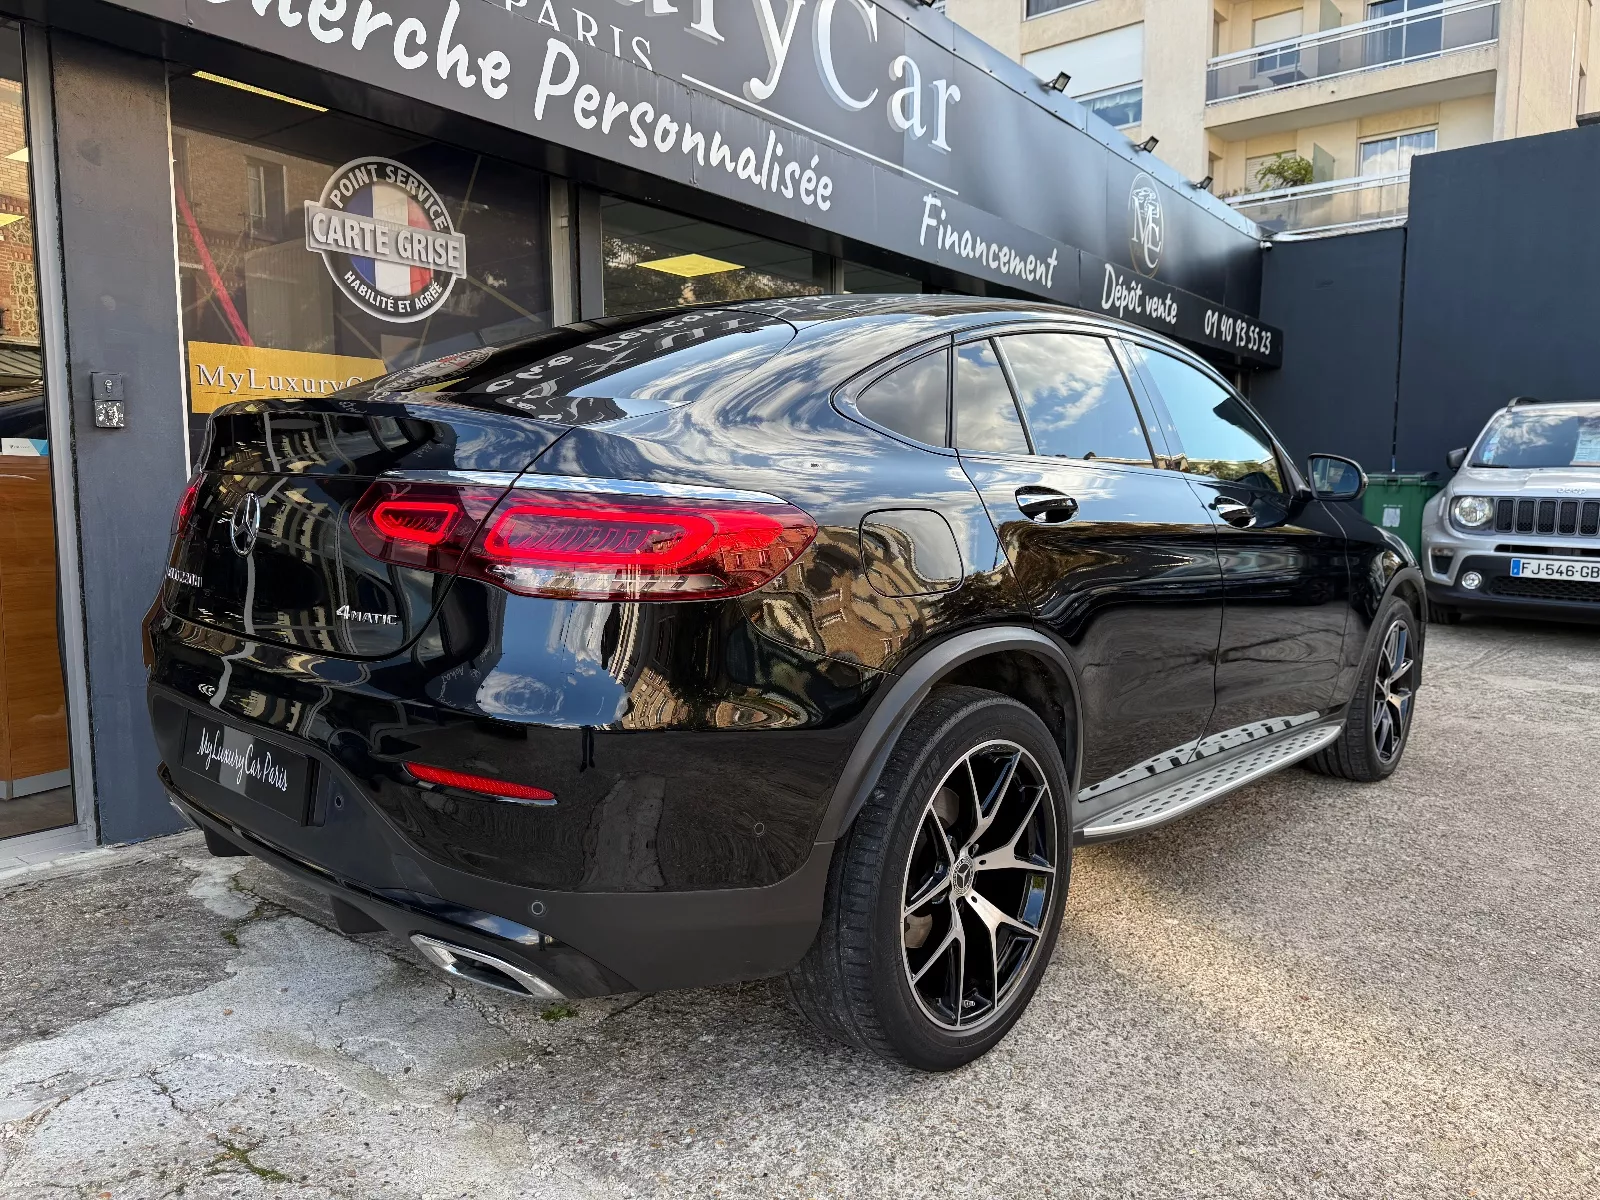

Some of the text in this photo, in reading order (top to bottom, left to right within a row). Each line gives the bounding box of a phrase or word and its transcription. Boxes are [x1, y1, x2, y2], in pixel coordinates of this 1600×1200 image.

[534, 38, 833, 211] Personnalisée
[329, 164, 447, 231] POINT SERVICE
[312, 212, 461, 268] CARTE GRISE
[919, 193, 1057, 288] Financement
[343, 270, 395, 312] HABILITÉ
[398, 300, 411, 313] ET
[1101, 263, 1178, 324] Dépôt vente
[336, 604, 398, 625] 4MATIC
